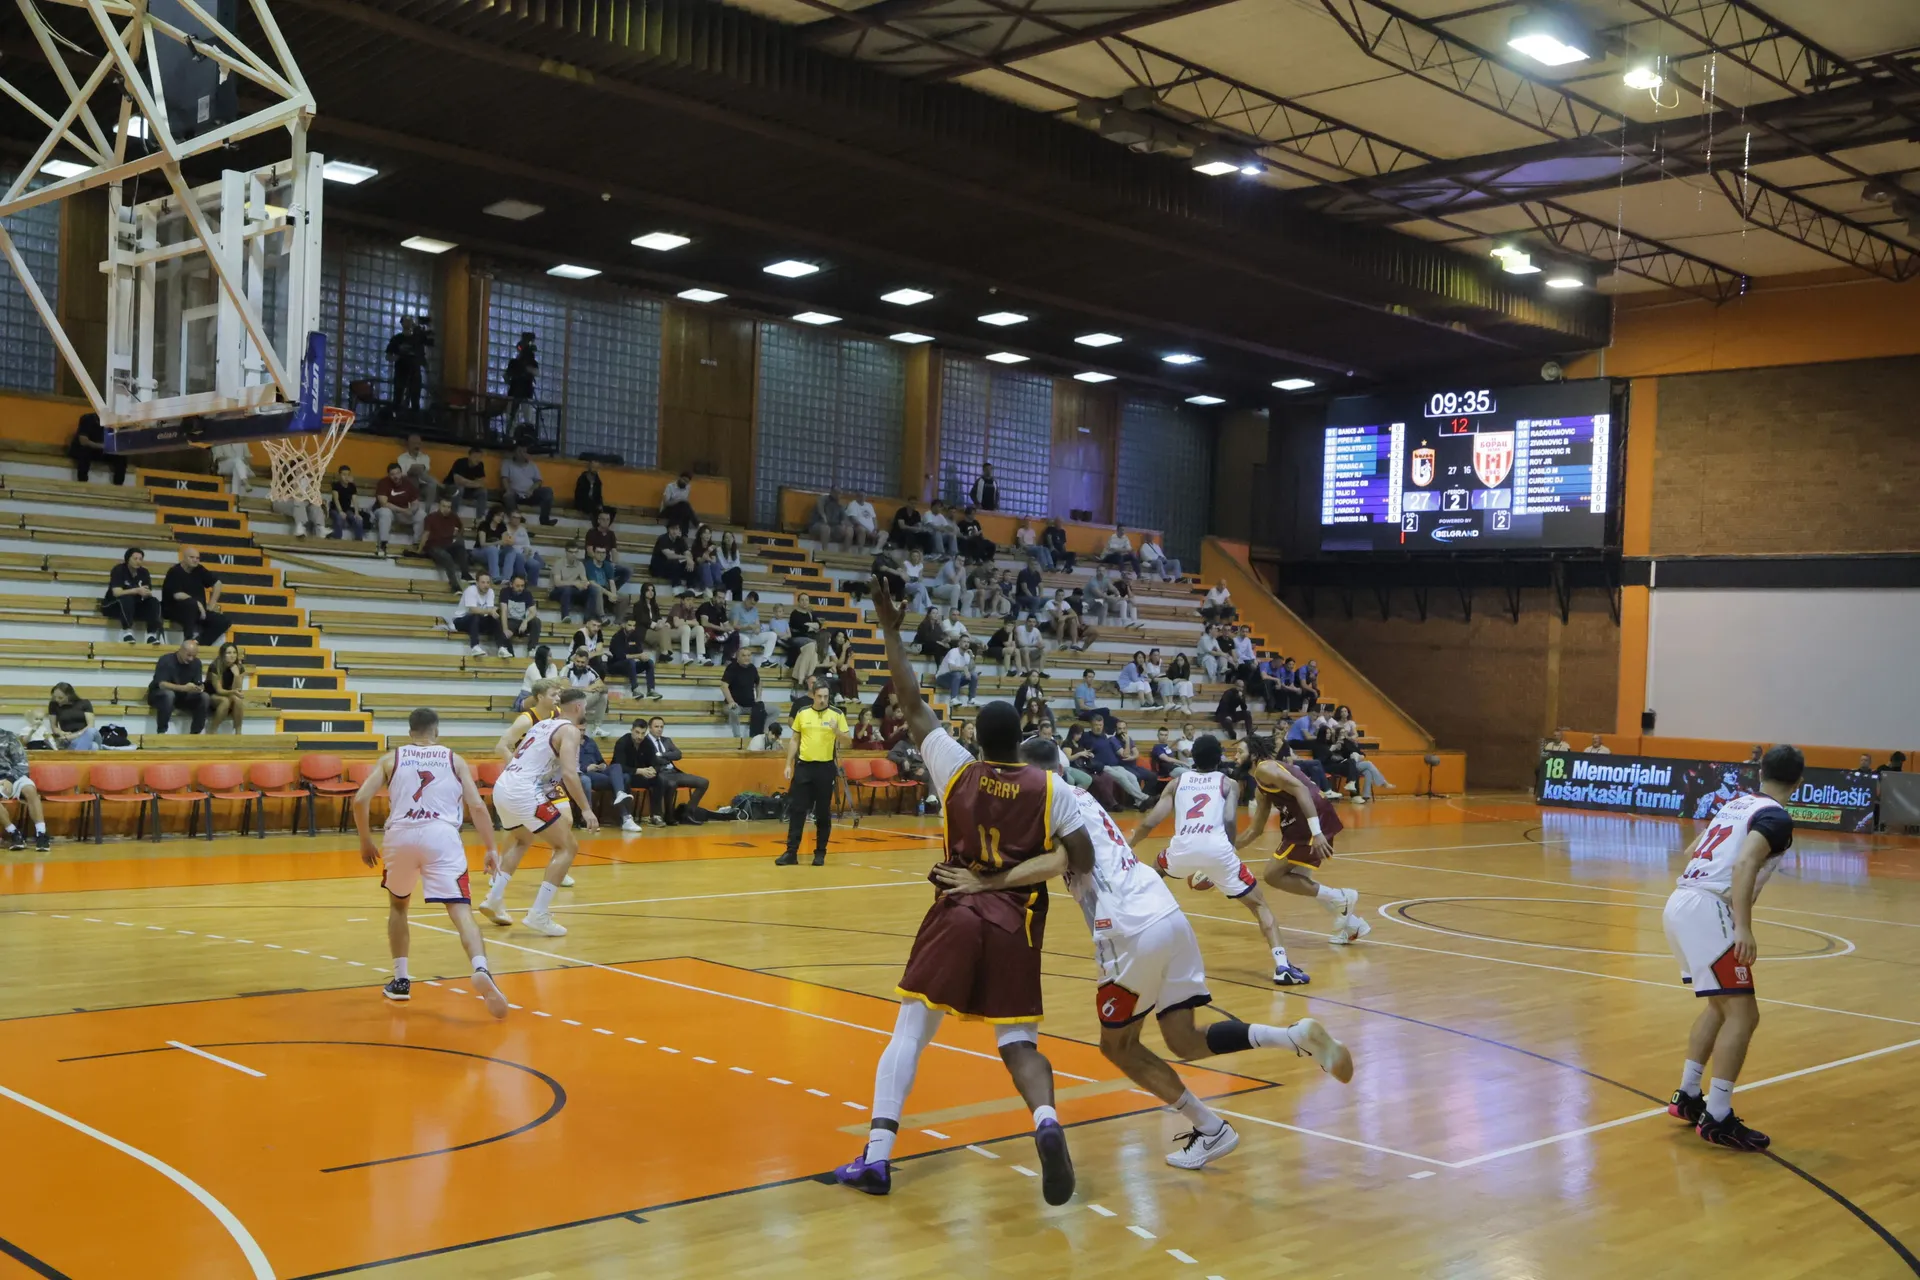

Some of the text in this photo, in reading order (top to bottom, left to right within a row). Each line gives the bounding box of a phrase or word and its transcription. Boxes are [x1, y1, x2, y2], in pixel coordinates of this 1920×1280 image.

[1431, 390, 1489, 415] 09:35
[1452, 418, 1468, 433] 12
[1530, 429, 1575, 437] RADOVANOVIC
[176, 481, 188, 490] IX
[1410, 493, 1431, 510] 27
[1450, 495, 1460, 509] 2
[1480, 490, 1501, 508] 17
[194, 517, 213, 527] VIII
[1406, 519, 1414, 530] 2
[1497, 516, 1505, 527] 2
[218, 555, 234, 565] VII
[244, 595, 255, 605] VI
[270, 636, 278, 647] V
[292, 677, 305, 688] IV
[321, 722, 332, 732] III
[1545, 758, 1672, 788] 18. Memorijalni
[412, 768, 435, 803] 7
[979, 776, 1019, 799] PERRY
[1543, 780, 1684, 810] košarkaški turnir
[1802, 784, 1871, 806] Delibašić
[1186, 793, 1211, 820] 2
[978, 824, 1003, 868] 11
[1102, 997, 1117, 1017] 6
